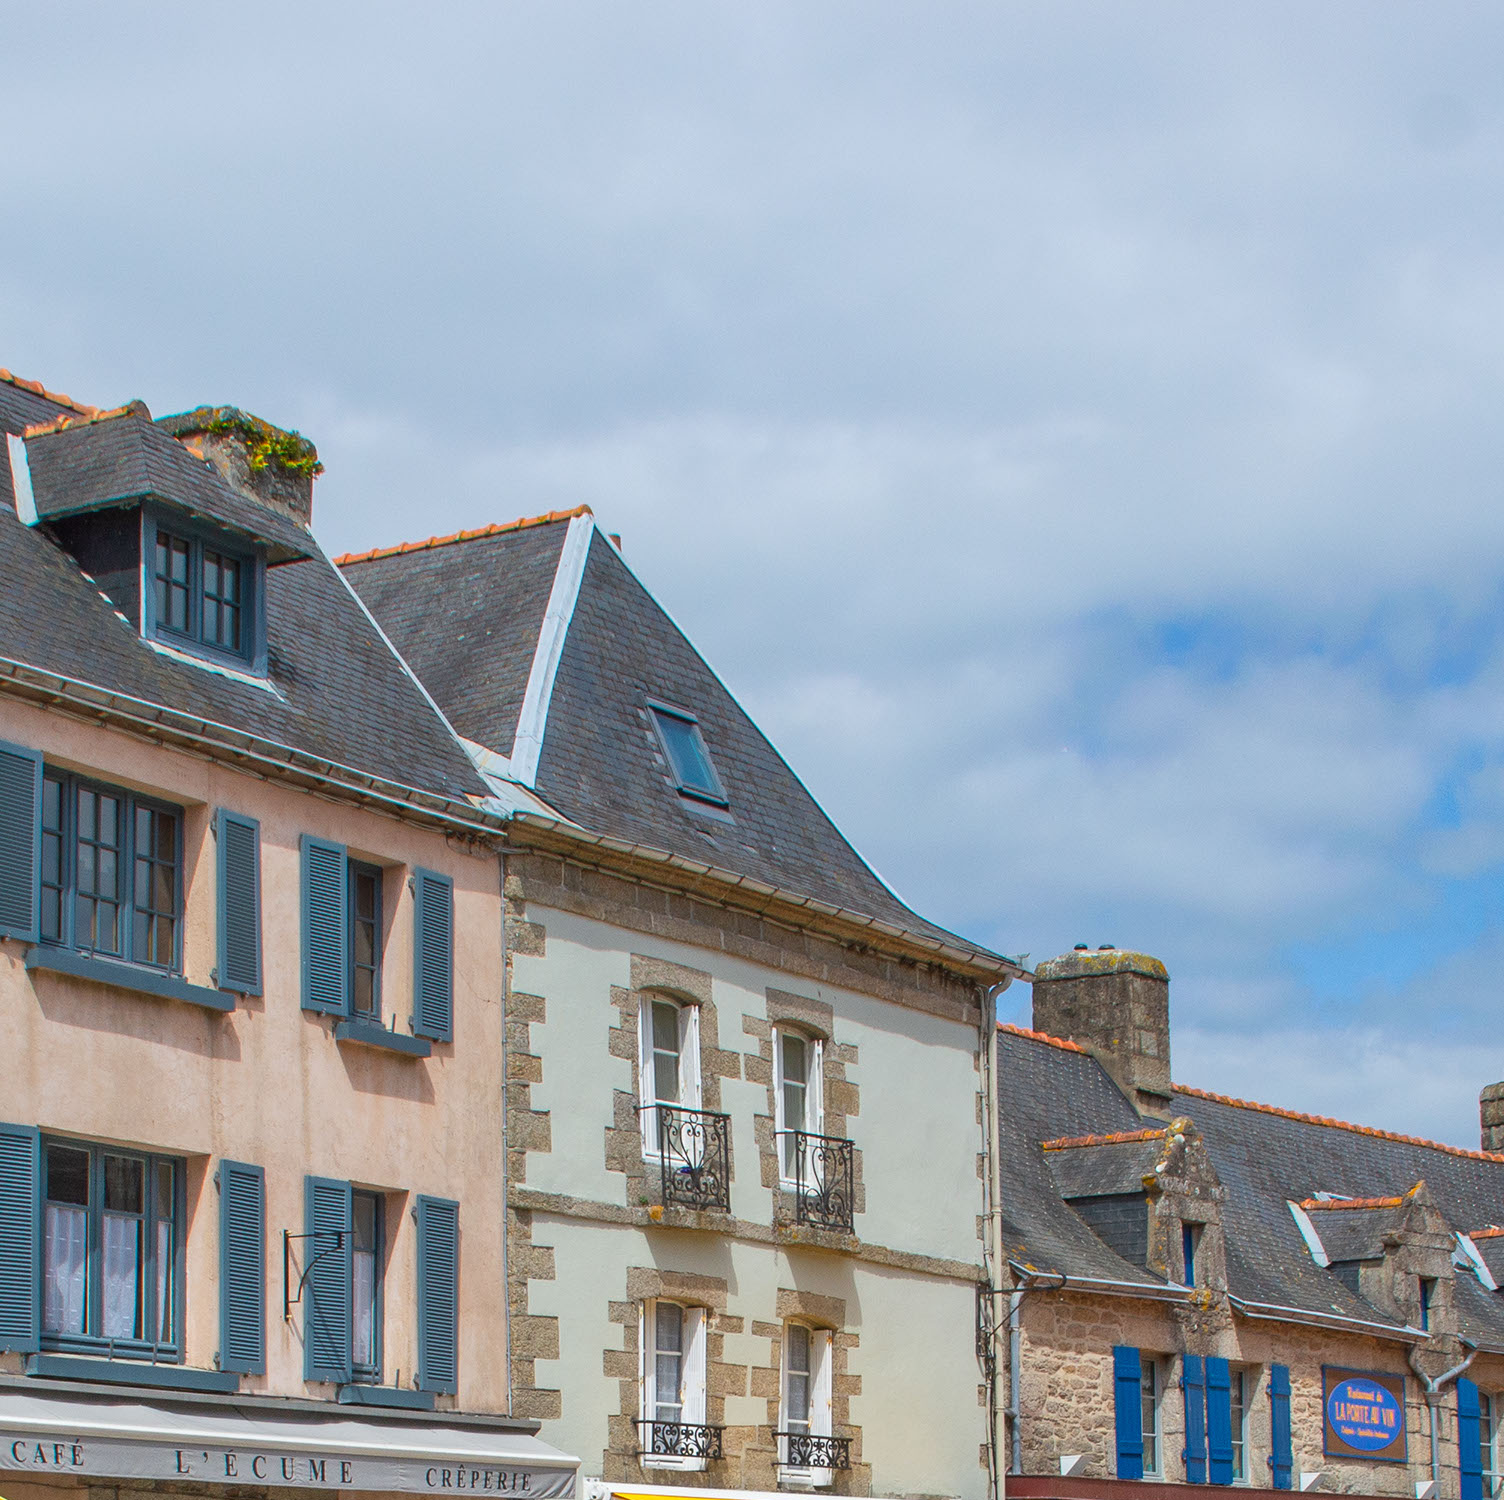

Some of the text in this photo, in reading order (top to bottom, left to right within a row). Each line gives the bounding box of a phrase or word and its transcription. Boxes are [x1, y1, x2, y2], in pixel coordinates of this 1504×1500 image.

[1335, 1402, 1395, 1427] LA PORTE AU VIN
[11, 1438, 84, 1467] CAFÉ
[175, 1449, 353, 1484] L'ÉCUME
[425, 1464, 532, 1491] CRÊPERIE
